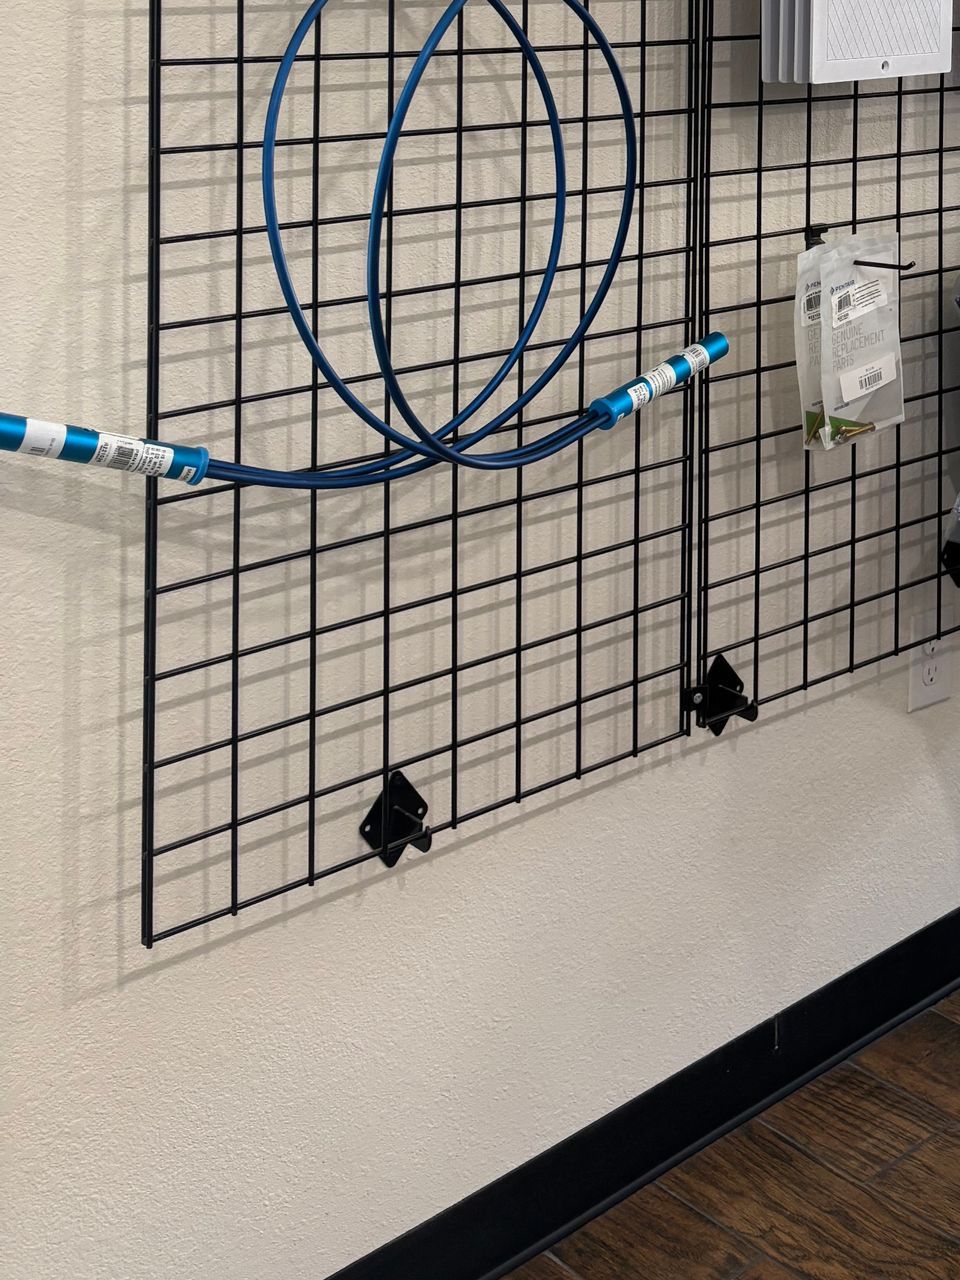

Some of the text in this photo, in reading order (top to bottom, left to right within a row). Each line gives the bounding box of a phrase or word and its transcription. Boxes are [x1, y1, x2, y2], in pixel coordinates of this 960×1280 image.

[835, 279, 855, 292] PENTAIR
[832, 323, 864, 347] GENUINE
[832, 329, 885, 358] REPLACEMENT
[832, 355, 855, 374] PARTS
